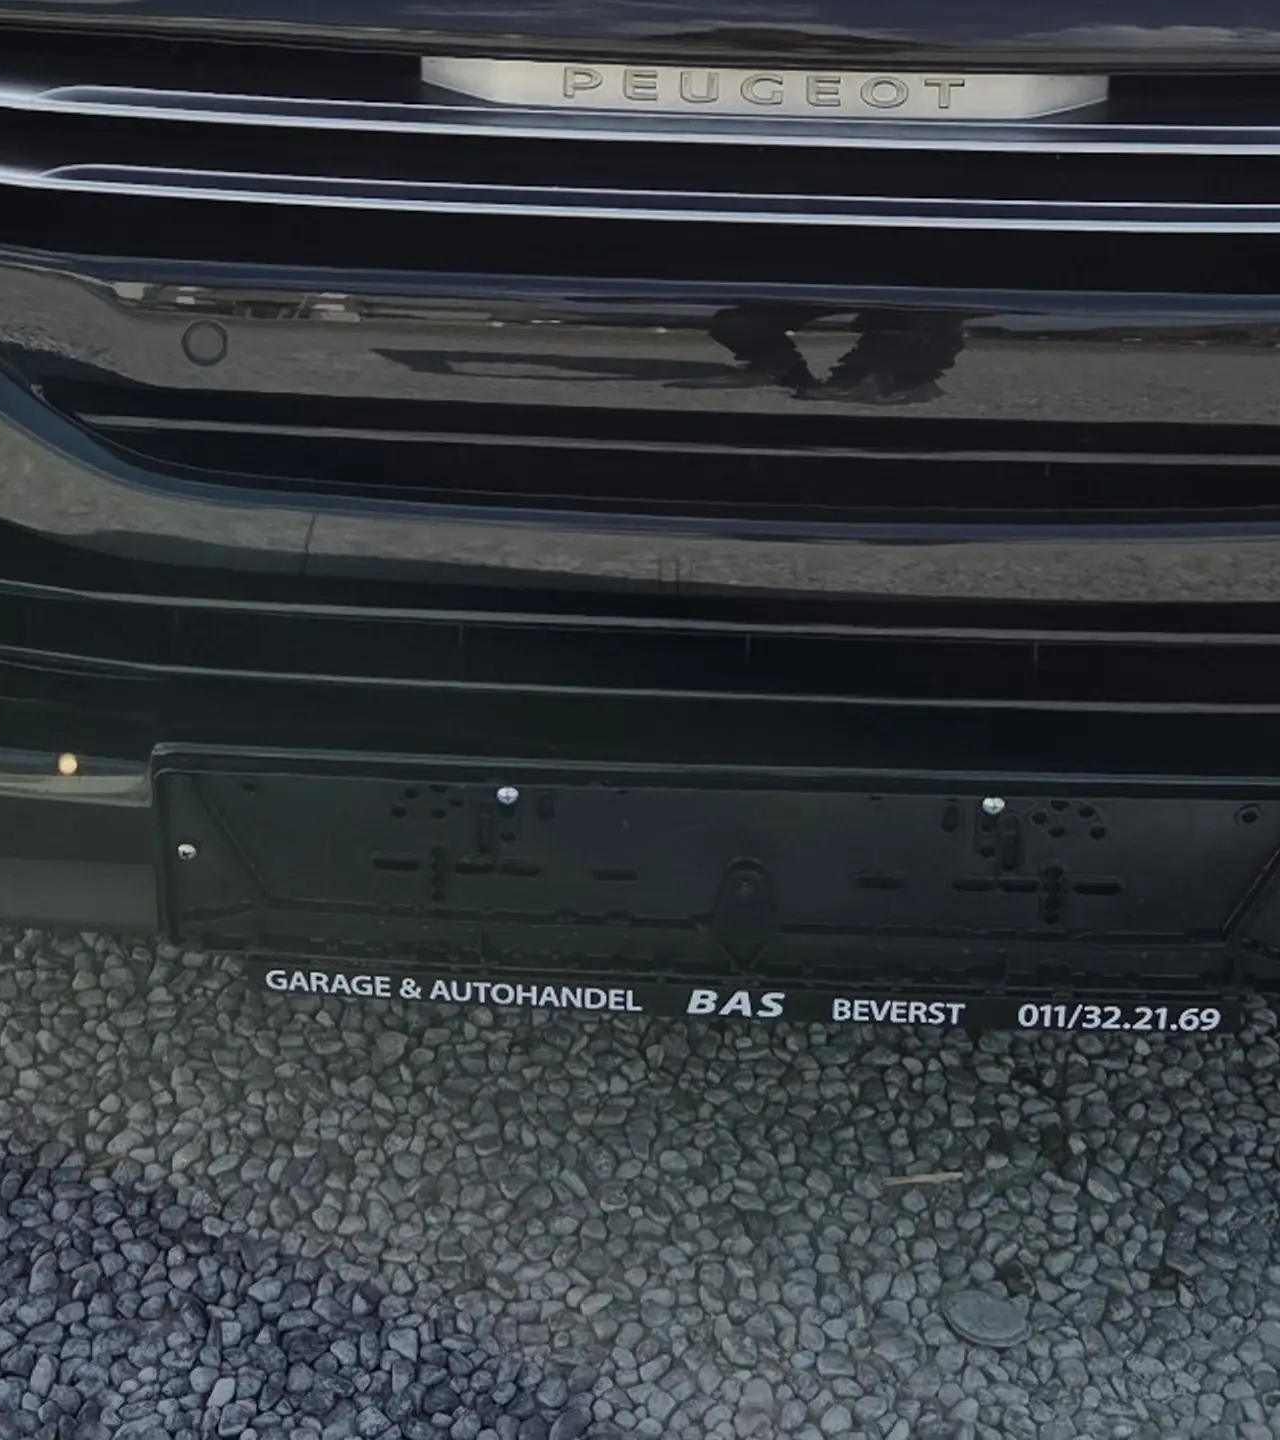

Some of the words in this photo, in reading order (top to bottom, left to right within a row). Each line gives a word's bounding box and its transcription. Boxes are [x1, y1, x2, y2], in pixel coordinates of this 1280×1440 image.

[562, 64, 967, 110] PEUGEOT
[265, 969, 391, 998] GARAGE
[399, 976, 421, 1000] &
[430, 979, 642, 1012] AUTOHANDEL
[686, 989, 786, 1018] BAS
[832, 998, 966, 1026] BEVERST
[1018, 1003, 1221, 1031] 011/32.21.69
